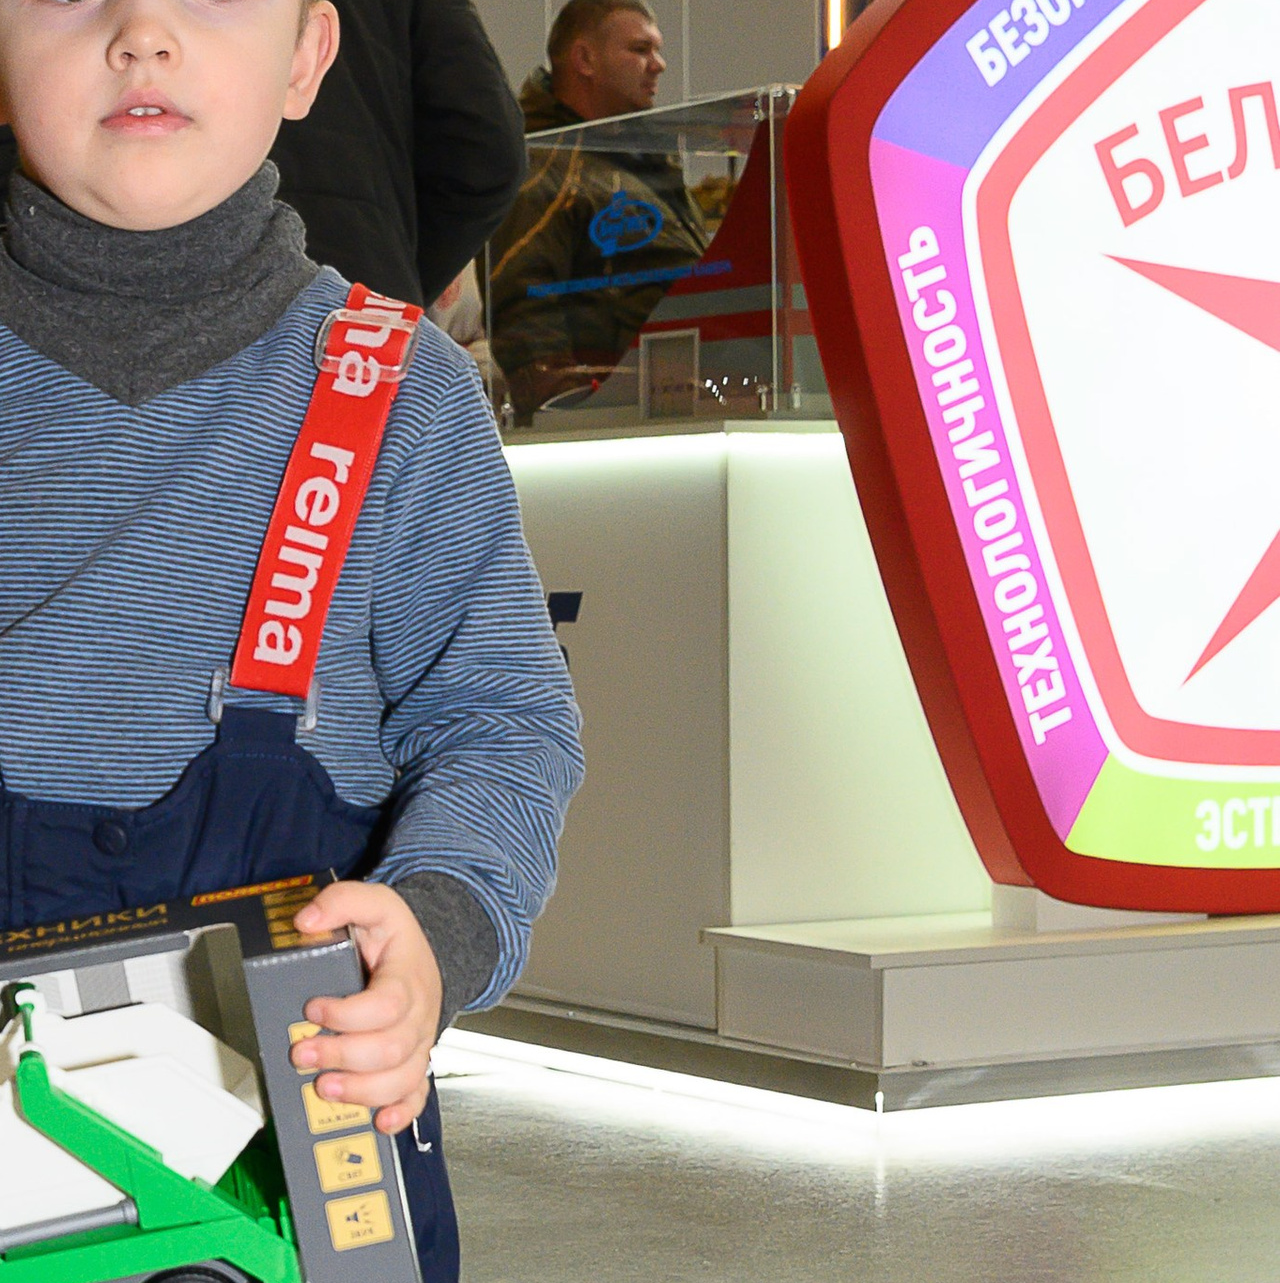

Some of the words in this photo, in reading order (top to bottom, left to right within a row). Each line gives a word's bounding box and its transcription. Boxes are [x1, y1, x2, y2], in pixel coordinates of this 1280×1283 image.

[1094, 81, 1280, 228] БЕЛ
[253, 441, 356, 667] reima
[897, 225, 1073, 746] ТЕХНОЛОГИЧНОСТЬ
